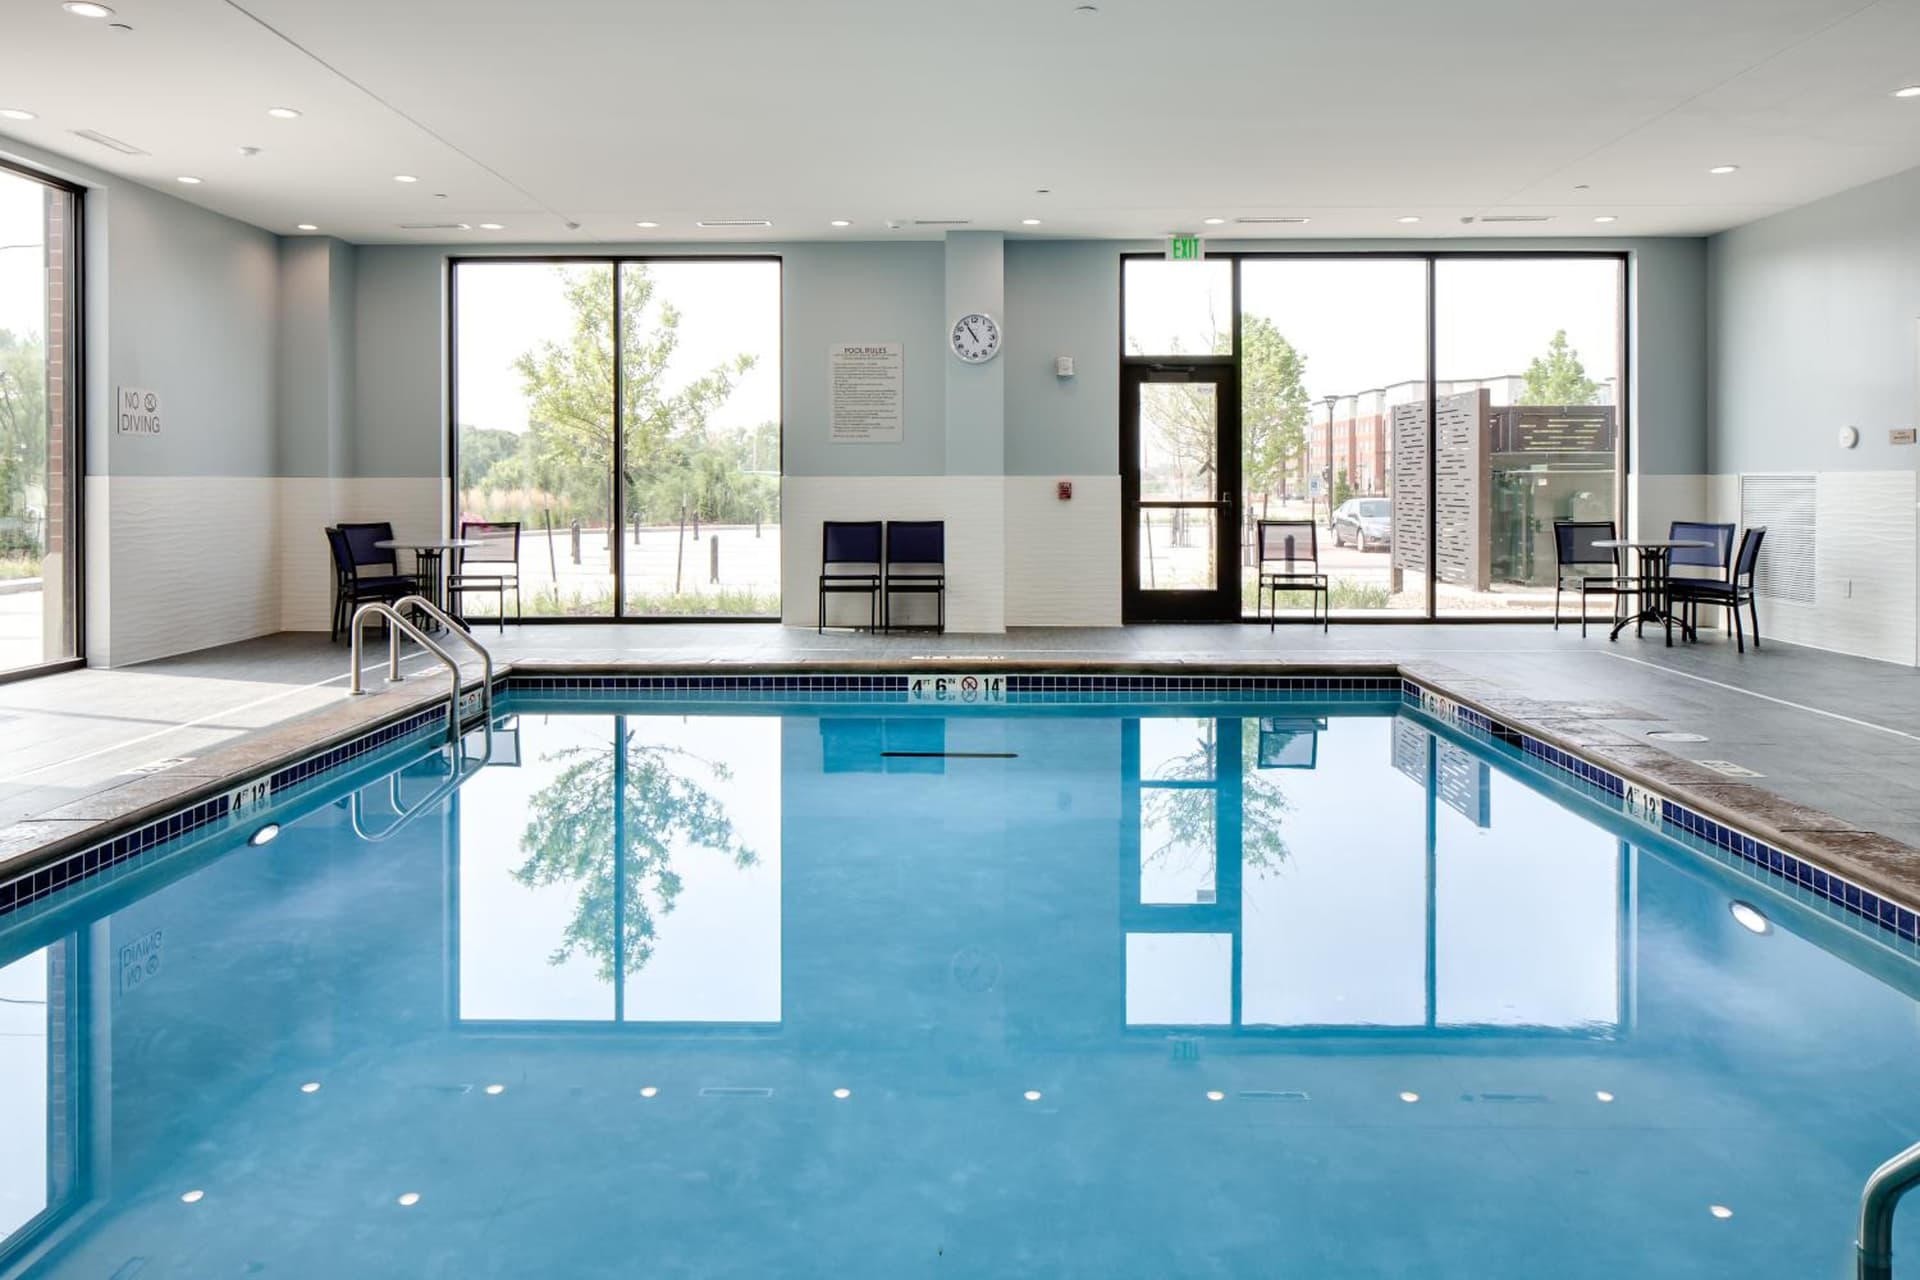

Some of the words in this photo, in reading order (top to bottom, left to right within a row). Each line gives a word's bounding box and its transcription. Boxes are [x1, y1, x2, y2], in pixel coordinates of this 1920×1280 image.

[1173, 239, 1199, 259] EXIT
[124, 391, 140, 410] NO
[121, 414, 161, 433] DIVING
